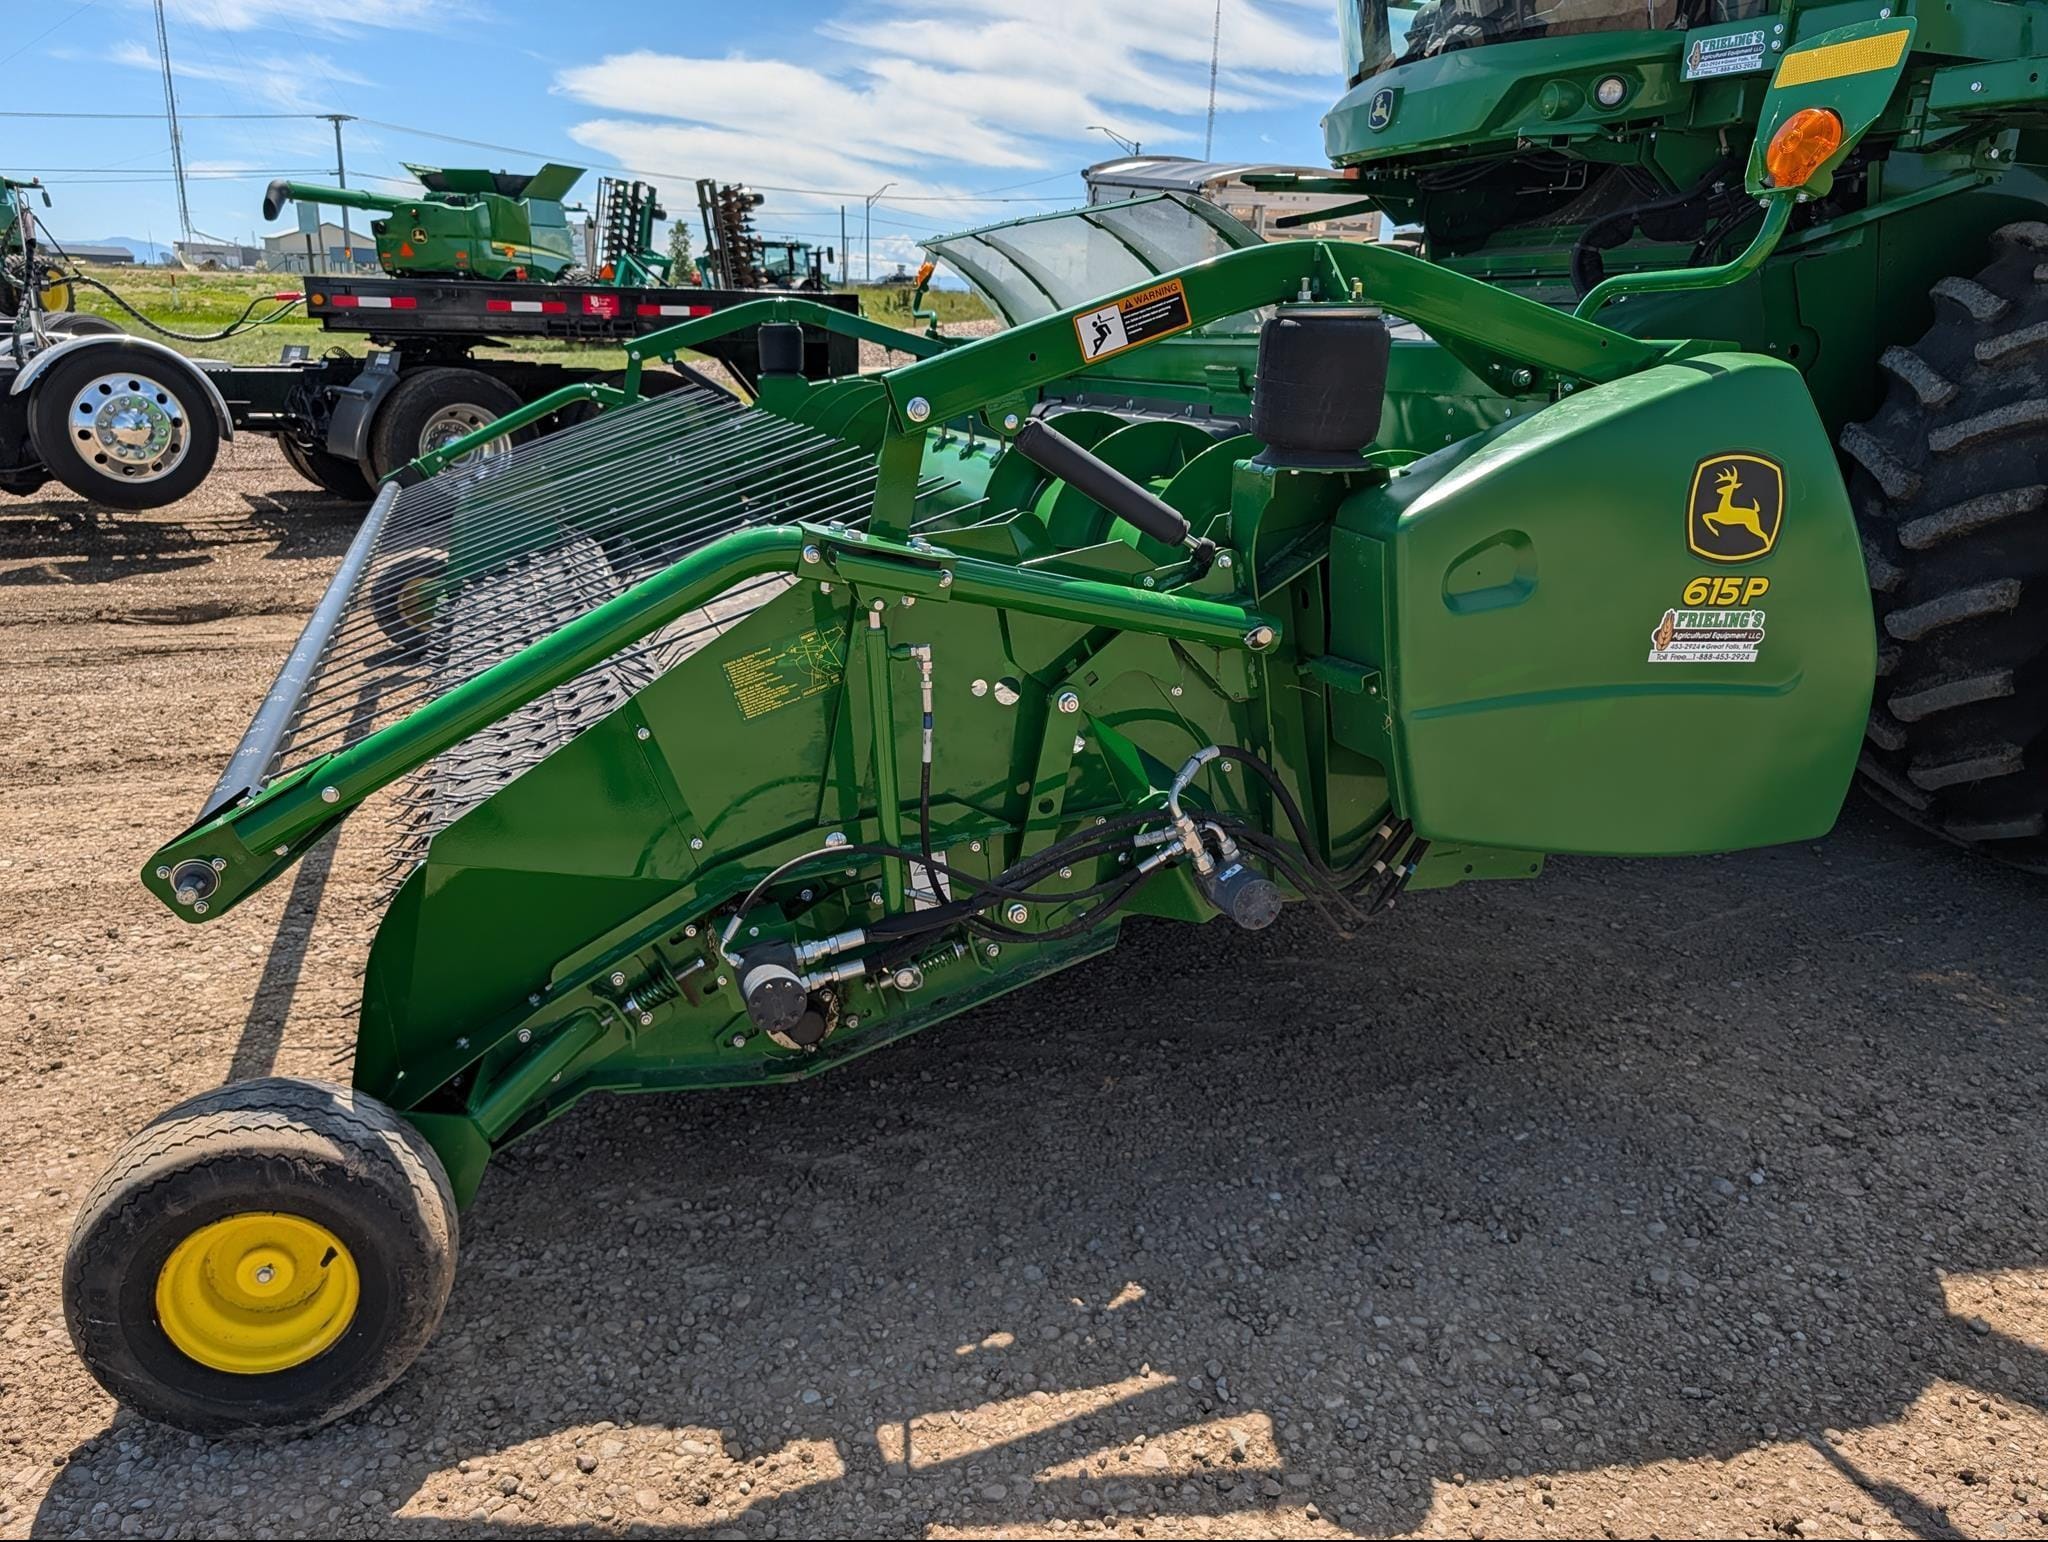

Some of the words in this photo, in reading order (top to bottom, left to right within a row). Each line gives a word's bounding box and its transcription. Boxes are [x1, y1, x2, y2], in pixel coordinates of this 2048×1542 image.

[1701, 32, 1763, 51] FRIELING'S
[1134, 283, 1178, 304] WARNING
[1682, 576, 1770, 606] 615P
[1675, 612, 1764, 628] FRIELING'S
[1672, 632, 1712, 640] Agricultural
[1712, 632, 1747, 640] Equipment
